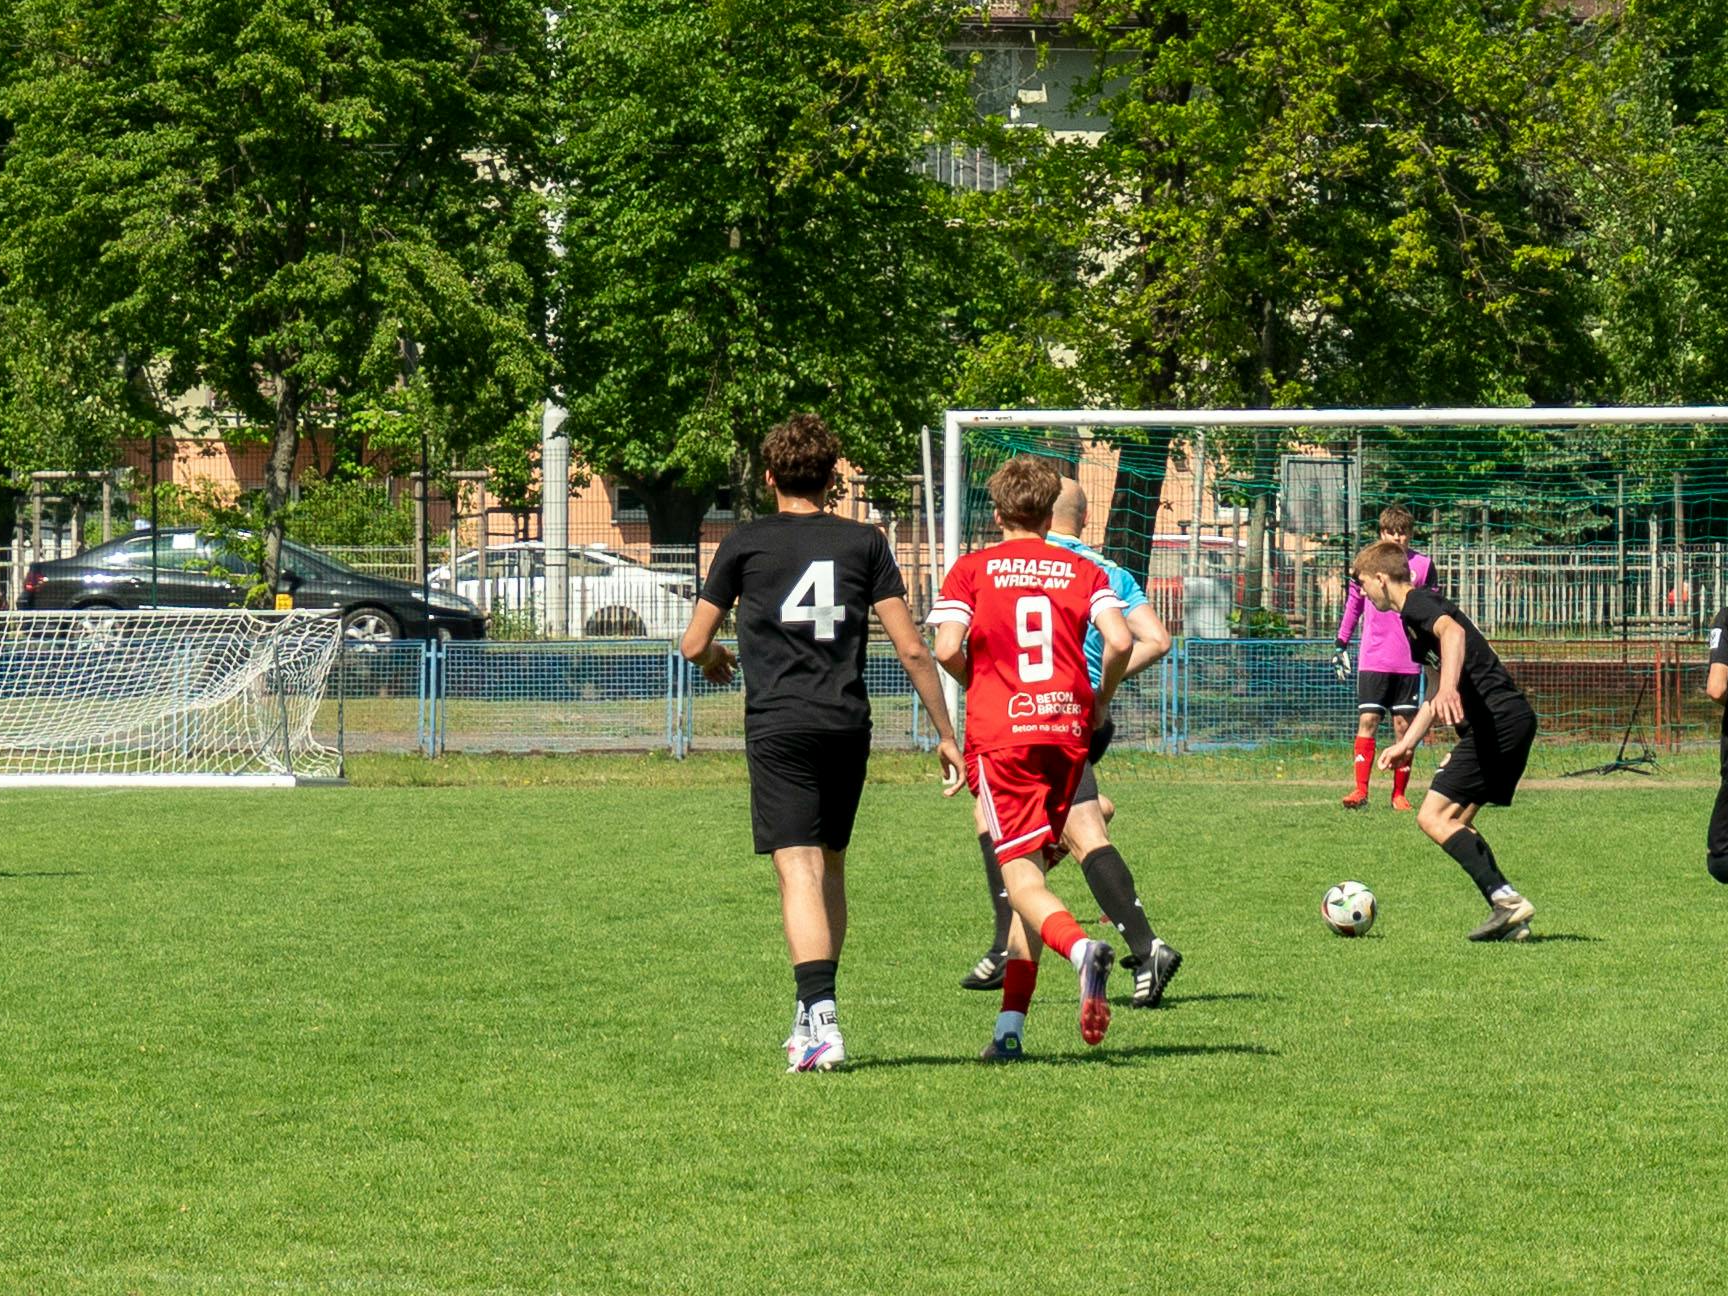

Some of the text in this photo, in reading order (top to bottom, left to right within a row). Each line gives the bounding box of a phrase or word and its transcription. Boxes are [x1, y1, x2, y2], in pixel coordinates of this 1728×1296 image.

[986, 558, 1076, 578] PARASOL
[780, 559, 846, 640] 4
[1015, 594, 1054, 683] 9
[1035, 691, 1074, 704] BETON
